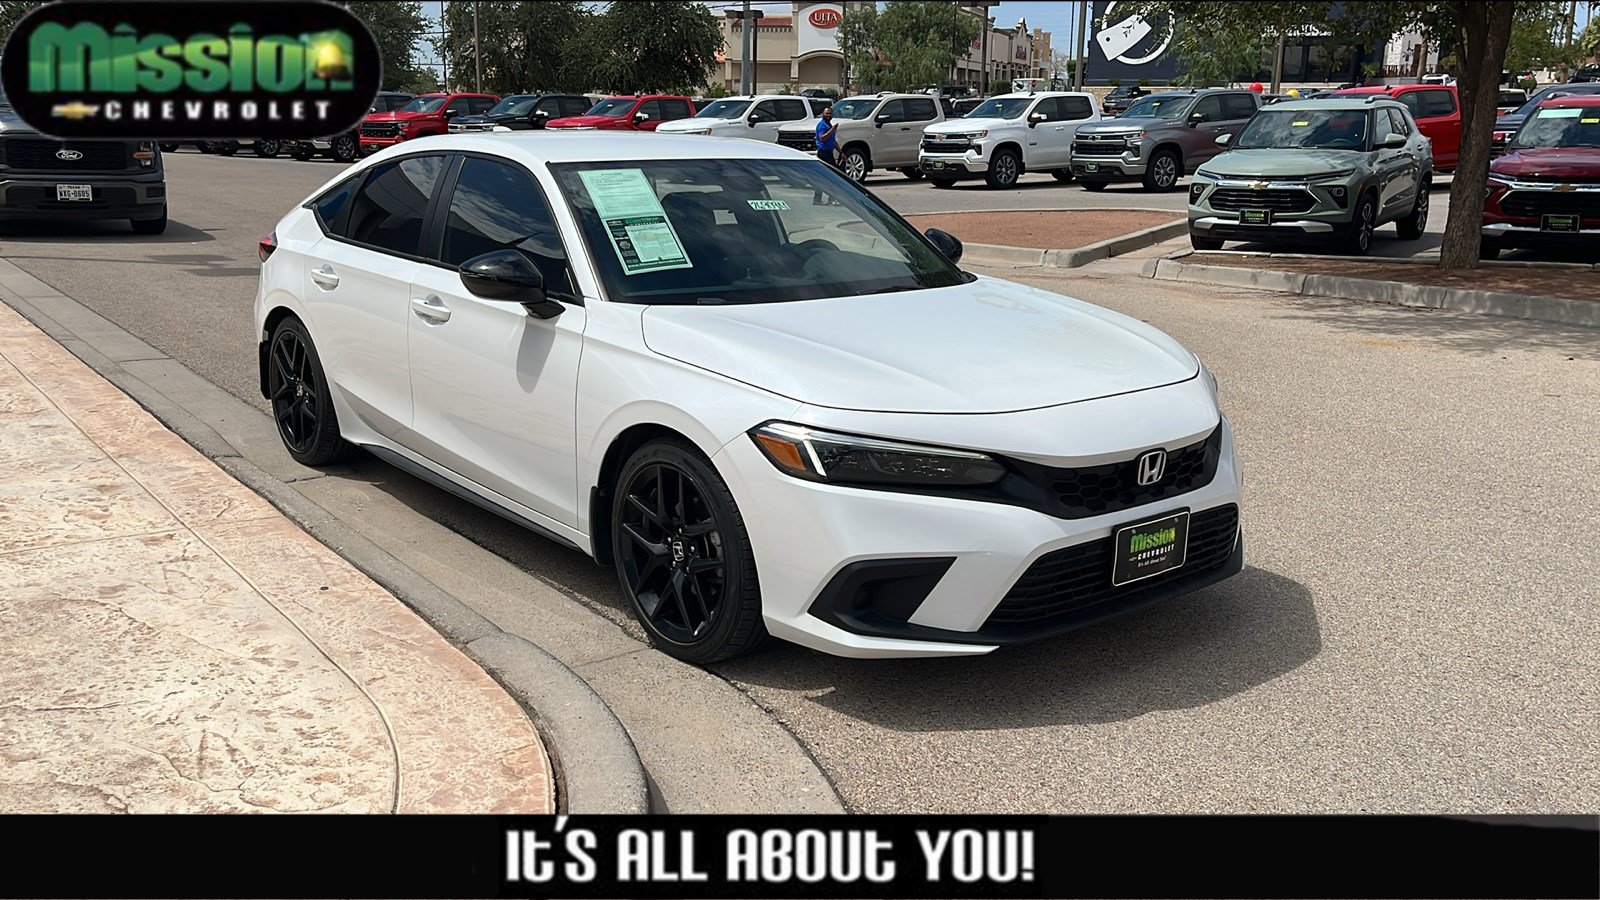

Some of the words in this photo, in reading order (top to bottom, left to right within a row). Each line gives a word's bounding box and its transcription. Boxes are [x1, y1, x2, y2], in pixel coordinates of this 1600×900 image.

[814, 12, 837, 21] ULTA
[1130, 527, 1176, 553] Mission
[1138, 544, 1174, 560] CHEVROLET
